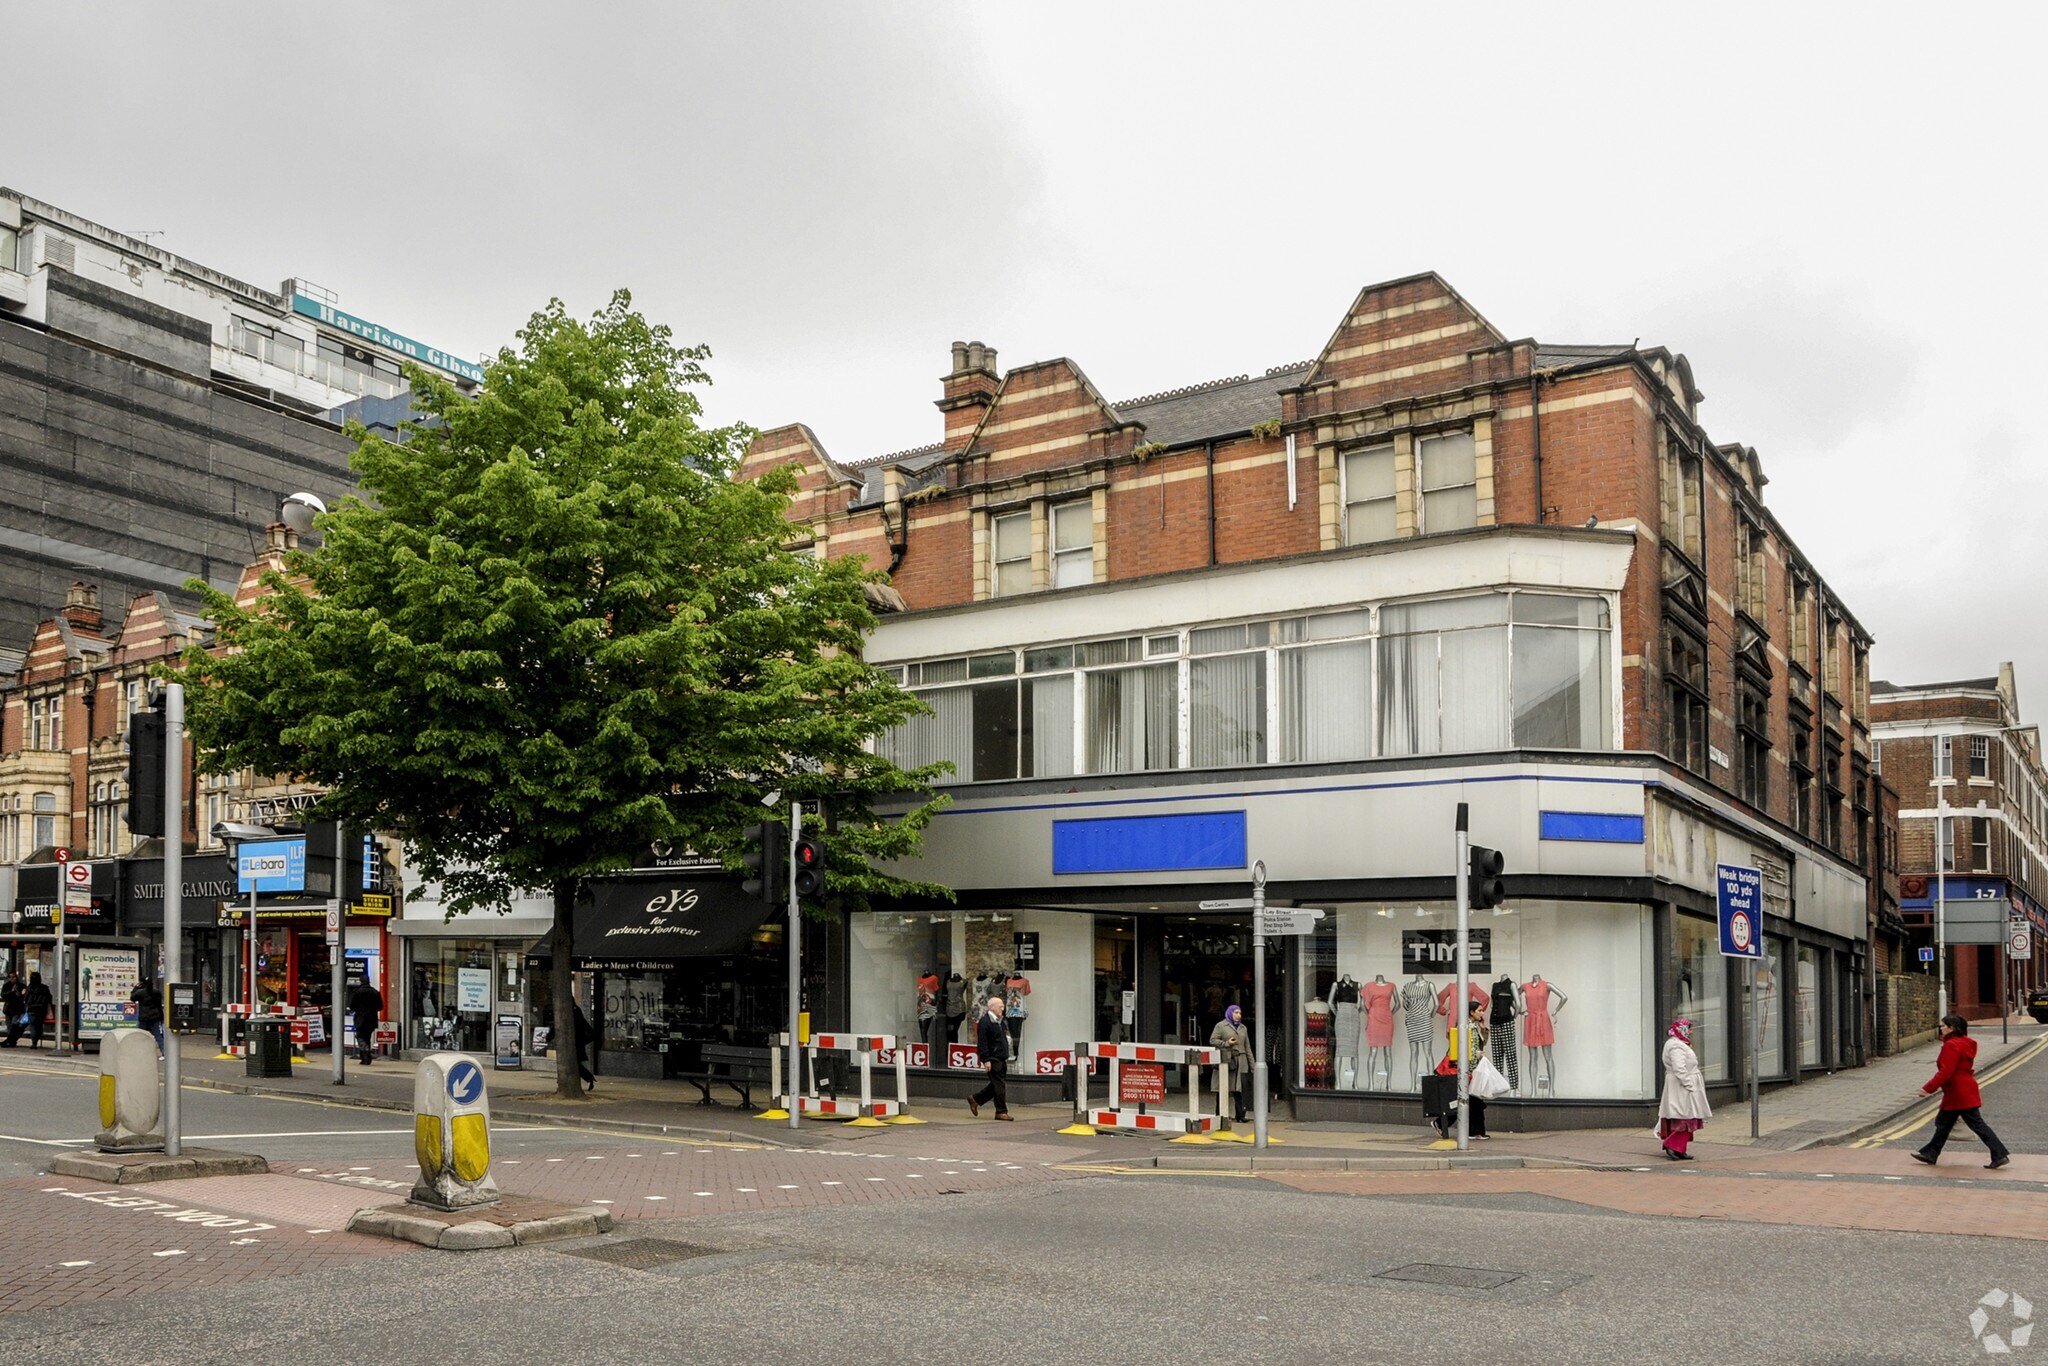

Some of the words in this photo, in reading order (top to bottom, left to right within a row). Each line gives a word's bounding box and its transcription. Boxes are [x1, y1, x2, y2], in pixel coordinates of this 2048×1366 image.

[319, 305, 418, 356] Harrison
[427, 347, 482, 382] Gibso
[59, 850, 67, 861] S
[249, 859, 285, 870] Lebara
[668, 858, 698, 866] Exclusive
[1718, 868, 1738, 881] Weak
[1738, 871, 1759, 885] bridge
[181, 881, 231, 898] GAMING
[1726, 882, 1739, 894] 100
[1741, 886, 1753, 897] yds
[1730, 897, 1750, 908] ahead
[24, 904, 49, 917] COFFEE
[217, 918, 241, 927] GOLD
[649, 917, 667, 925] for
[605, 925, 650, 937] Exclusive
[650, 925, 701, 936] Footwear
[1408, 942, 1483, 961] TIME
[82, 953, 136, 963] Lycamobile
[580, 961, 603, 969] Ladies
[636, 961, 674, 969] Childrens
[81, 1003, 107, 1014] 250
[153, 1209, 277, 1233] LOOK
